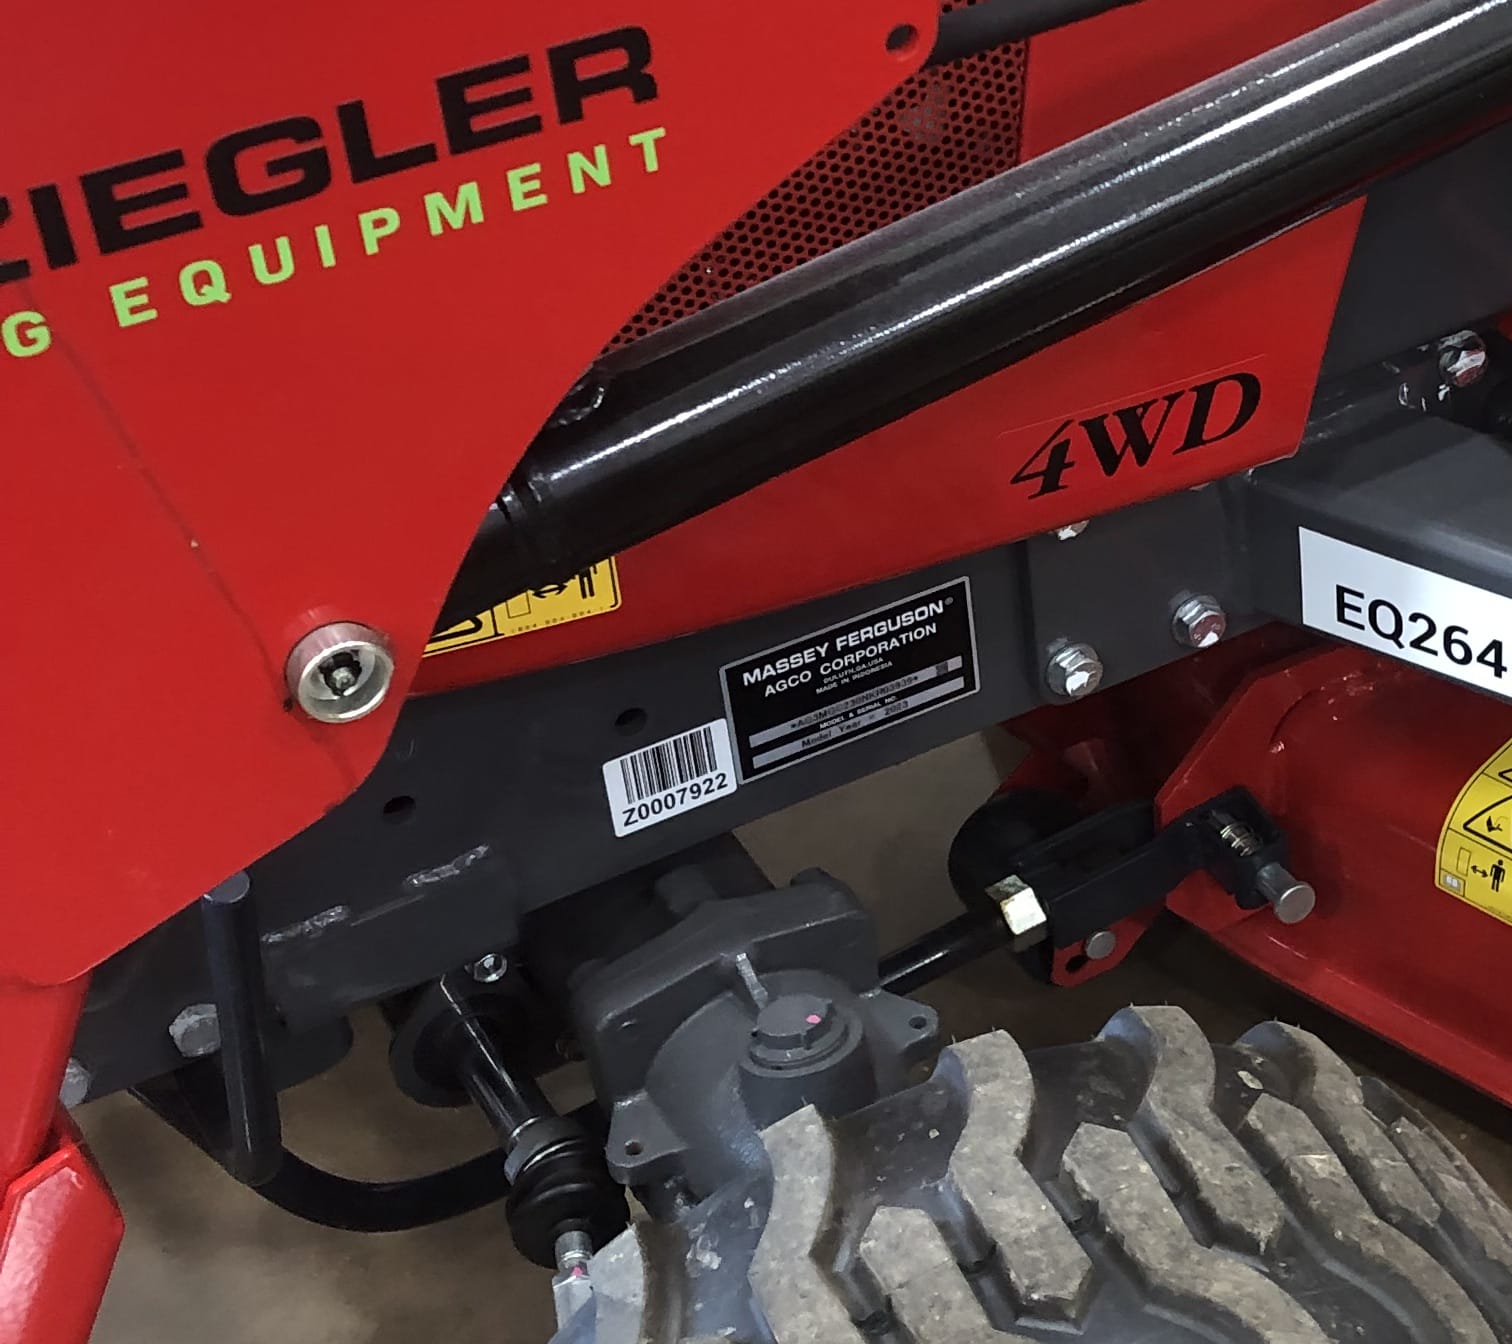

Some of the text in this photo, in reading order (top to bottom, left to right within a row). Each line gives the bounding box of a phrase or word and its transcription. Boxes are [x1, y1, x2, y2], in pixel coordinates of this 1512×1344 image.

[0, 25, 657, 285] IEGLER
[109, 127, 667, 328] EQUIPMENT
[1009, 372, 1262, 500] 4WD
[742, 599, 944, 686] MASSEY FERGUSON
[764, 622, 937, 697] AGCO CORPORATION
[622, 773, 728, 827] Z0007922
